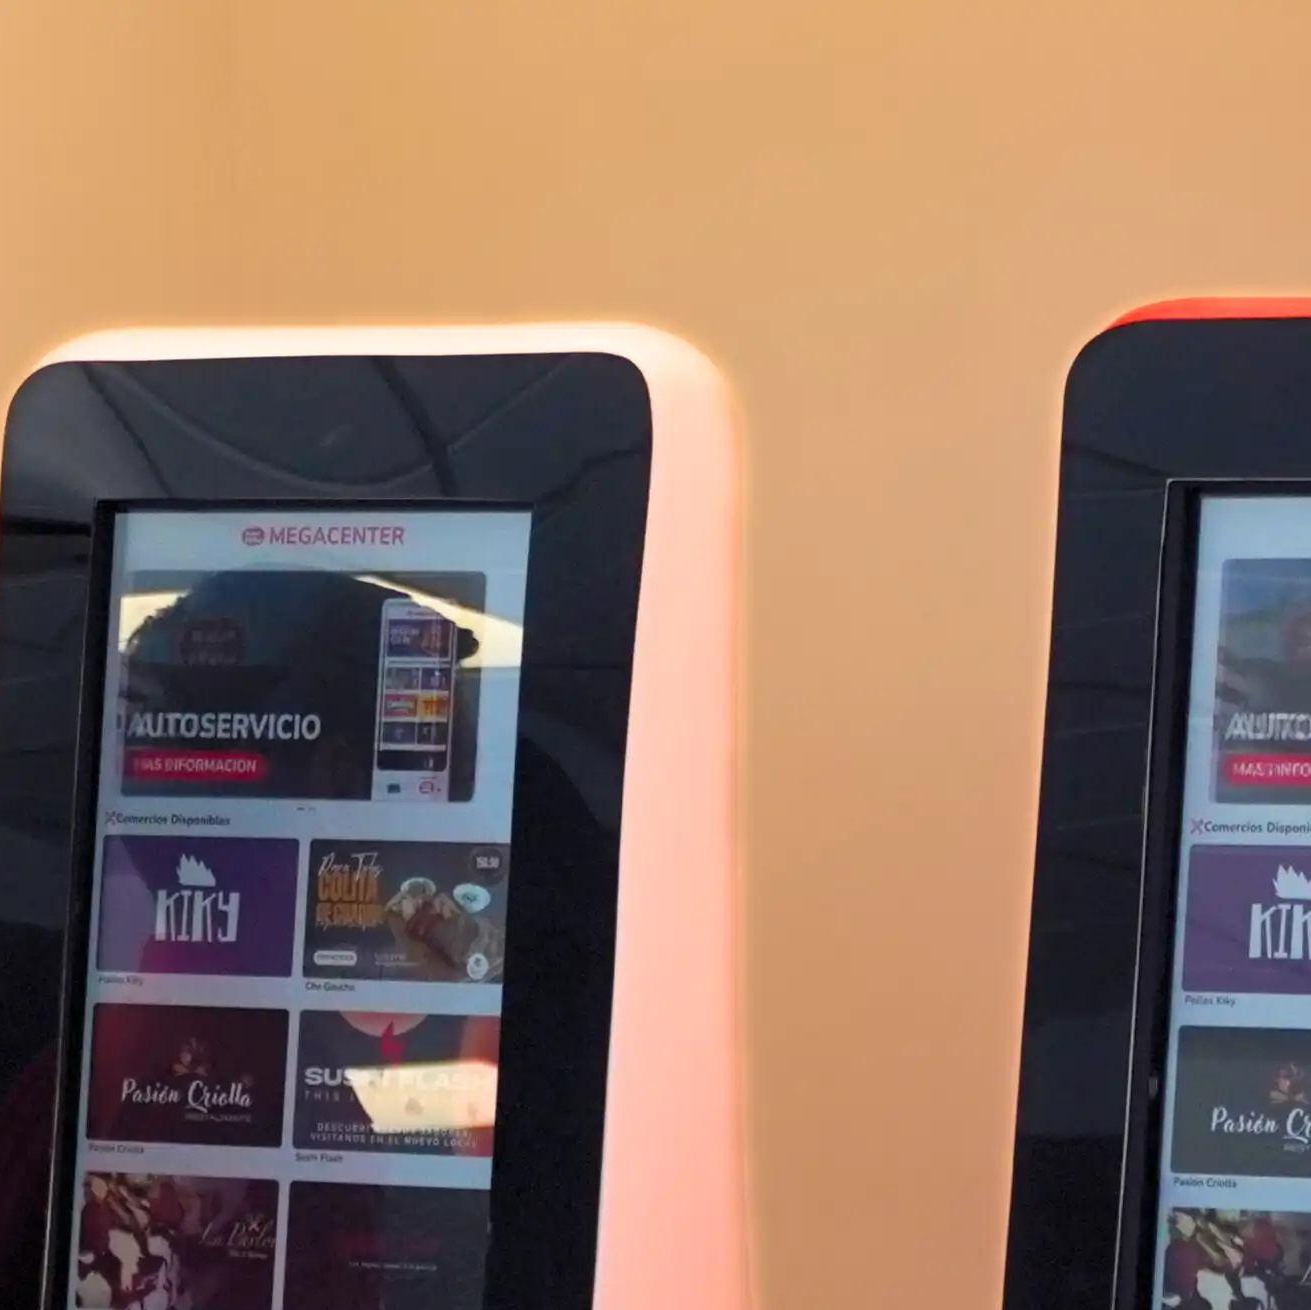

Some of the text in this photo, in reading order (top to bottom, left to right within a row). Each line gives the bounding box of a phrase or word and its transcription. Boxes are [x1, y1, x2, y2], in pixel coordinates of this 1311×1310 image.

[269, 526, 405, 545] MEGACENTER
[127, 712, 322, 740] AUTOSERVICIO
[117, 813, 231, 827] Comercios Disponibles
[1204, 821, 1263, 833] Comercios
[155, 889, 240, 942] KIKY
[121, 1078, 180, 1103] Pasión
[1211, 1106, 1280, 1133] Pasión
[310, 1132, 366, 1144] VISITANOS
[404, 1135, 440, 1146] NUEVO
[443, 1137, 478, 1148] LOCAL
